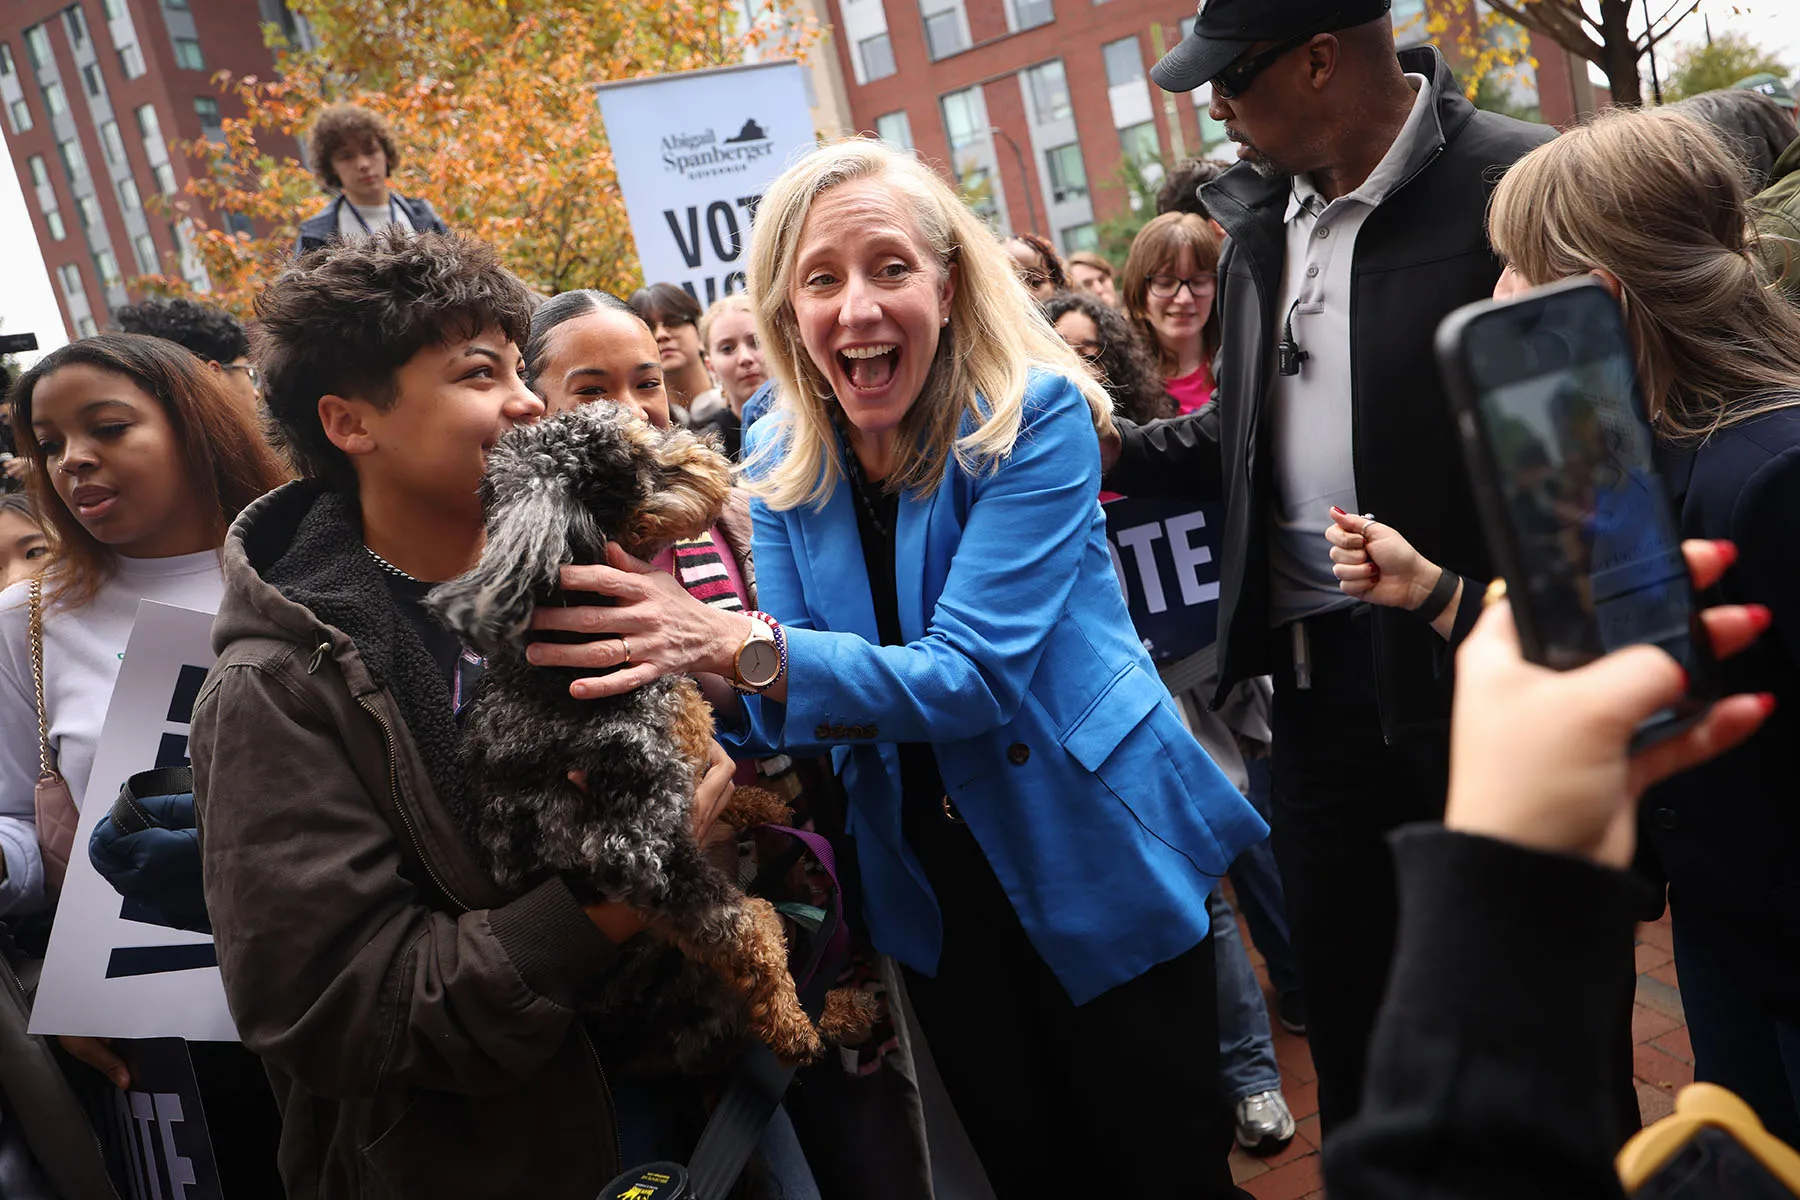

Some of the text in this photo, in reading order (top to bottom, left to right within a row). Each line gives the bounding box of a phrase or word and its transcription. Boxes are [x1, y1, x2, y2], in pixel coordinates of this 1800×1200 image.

[661, 127, 716, 150] Abigail
[662, 141, 774, 174] Spanberger
[1106, 510, 1221, 615] TE
